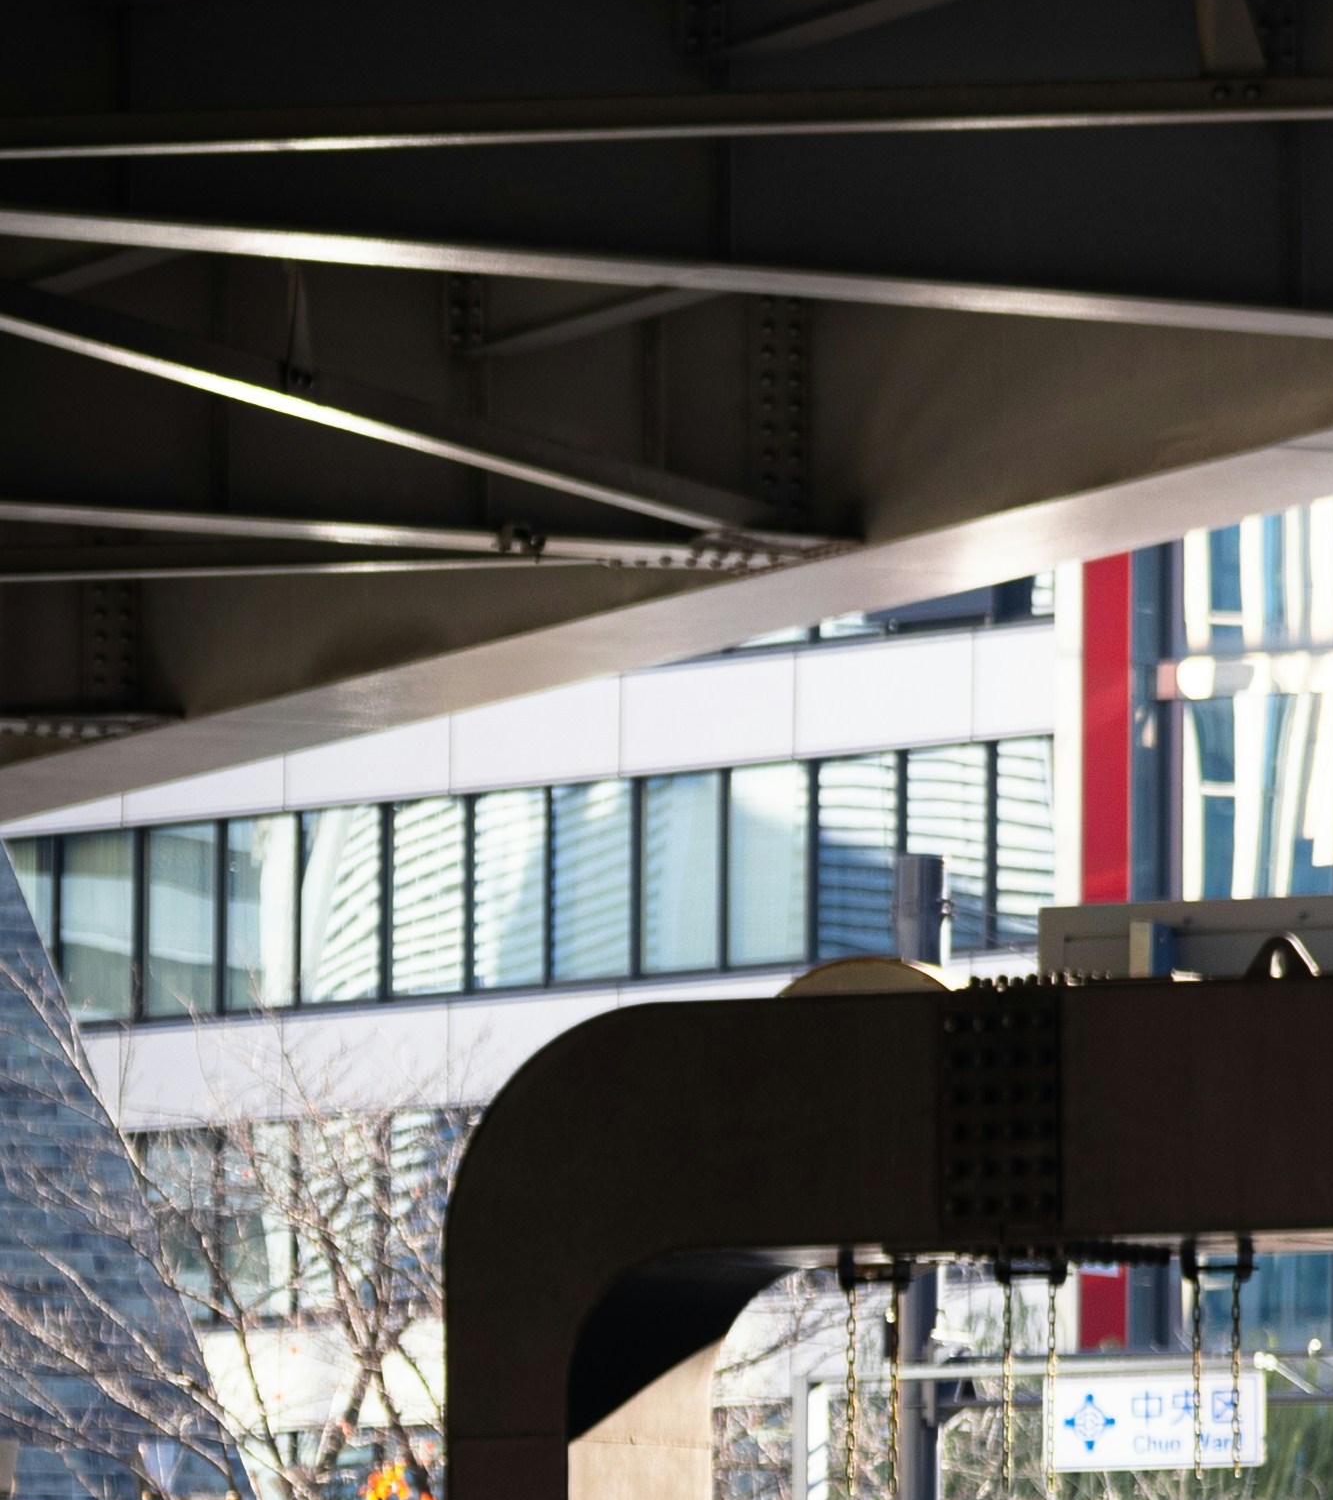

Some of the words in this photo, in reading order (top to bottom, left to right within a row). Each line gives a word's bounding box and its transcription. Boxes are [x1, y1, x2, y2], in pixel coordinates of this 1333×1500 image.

[1131, 1388, 1243, 1427] 中央区
[1134, 1434, 1181, 1454] Chuo
